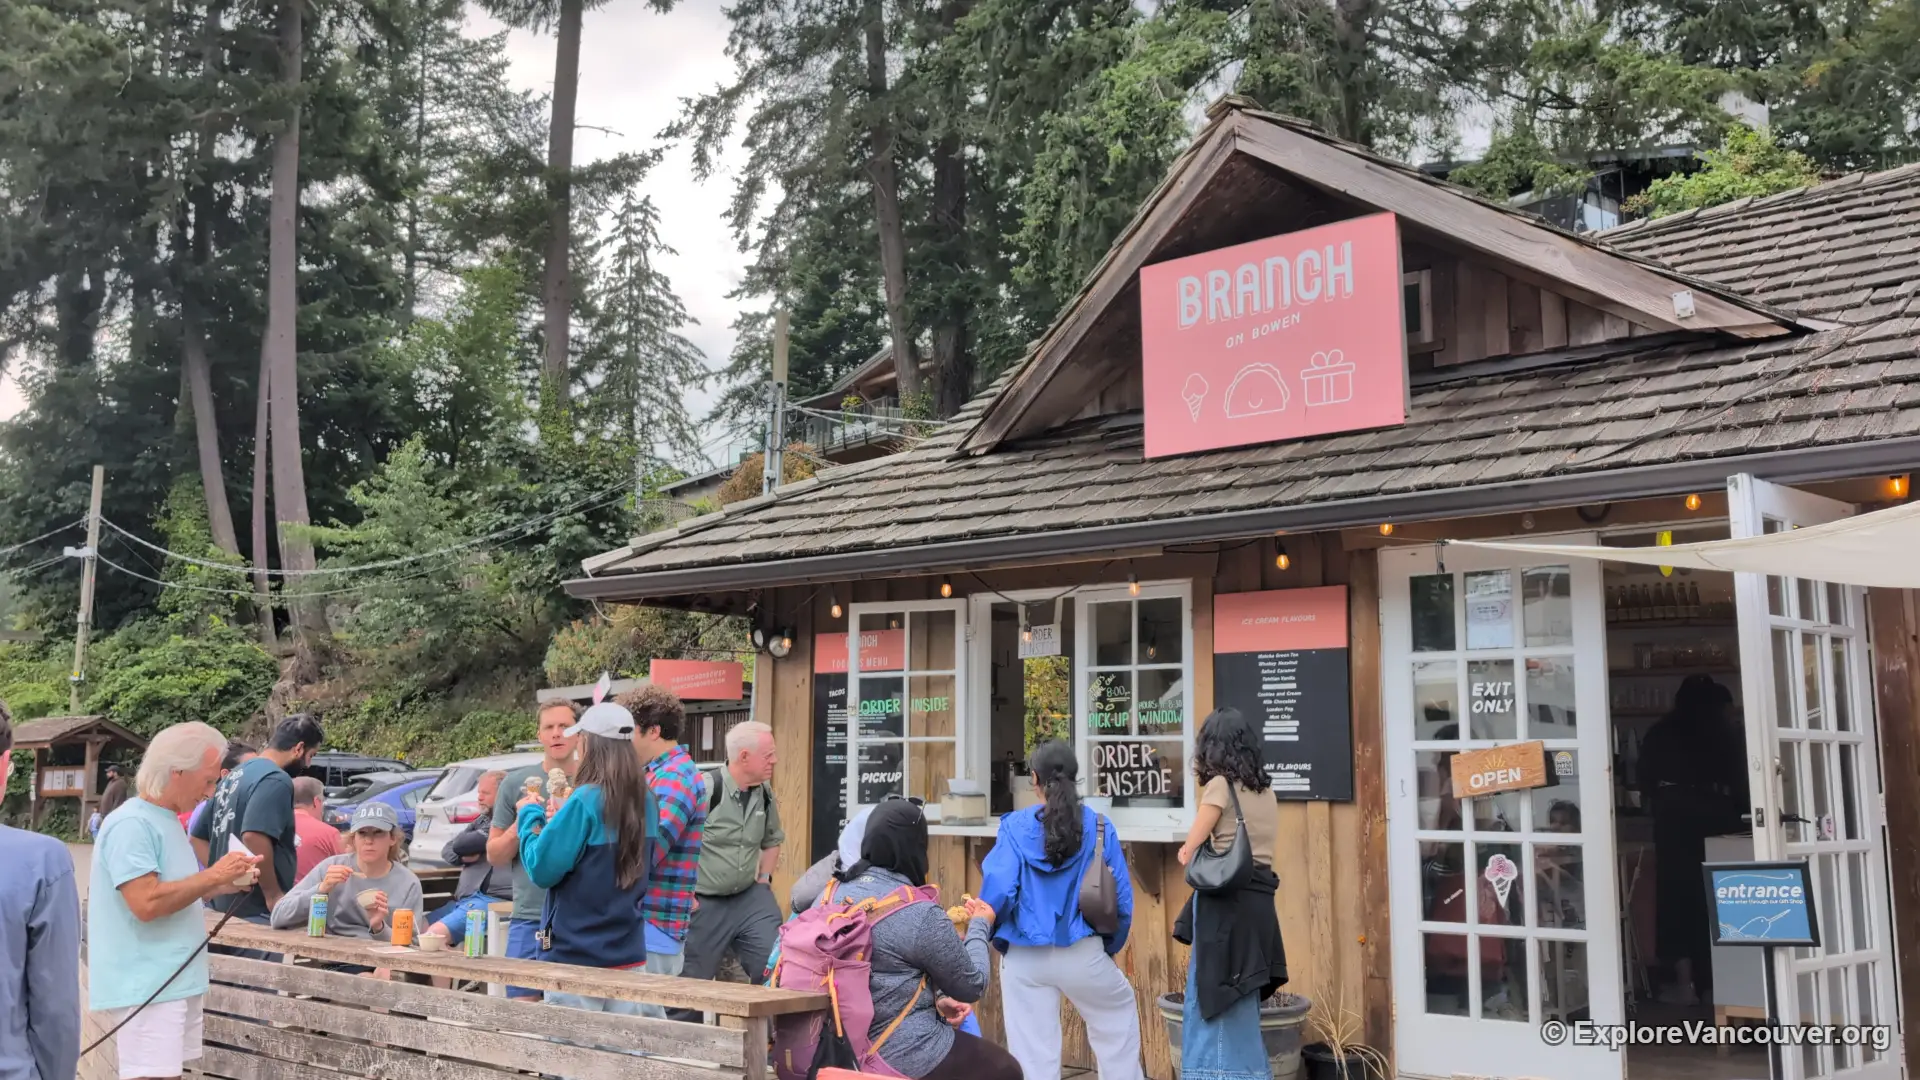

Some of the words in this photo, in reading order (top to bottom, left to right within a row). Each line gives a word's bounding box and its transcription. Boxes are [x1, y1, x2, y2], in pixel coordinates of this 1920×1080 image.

[1178, 241, 1353, 330] BRANCH
[1226, 333, 1244, 348] ON
[1252, 312, 1300, 339] BOWEN
[1255, 616, 1279, 624] CREAM
[1281, 613, 1316, 623] FLAVOURS
[1031, 627, 1053, 641] RDER
[867, 656, 888, 667] MENU
[828, 687, 846, 697] TACOS
[1472, 681, 1512, 697] EXIT
[860, 698, 900, 715] ORDER
[910, 696, 949, 713] INSIDE
[1471, 698, 1514, 713] ONLY
[1088, 712, 1129, 728] PICK-UP
[1138, 709, 1183, 725] WINDOW
[1091, 744, 1154, 768] ORDER
[1276, 763, 1312, 771] FLAVOURS
[861, 772, 902, 783] PICKUP
[1093, 769, 1172, 797] INSIDE
[1470, 767, 1522, 789] OPEN
[361, 807, 383, 817] DAD
[1717, 883, 1803, 898] entrance
